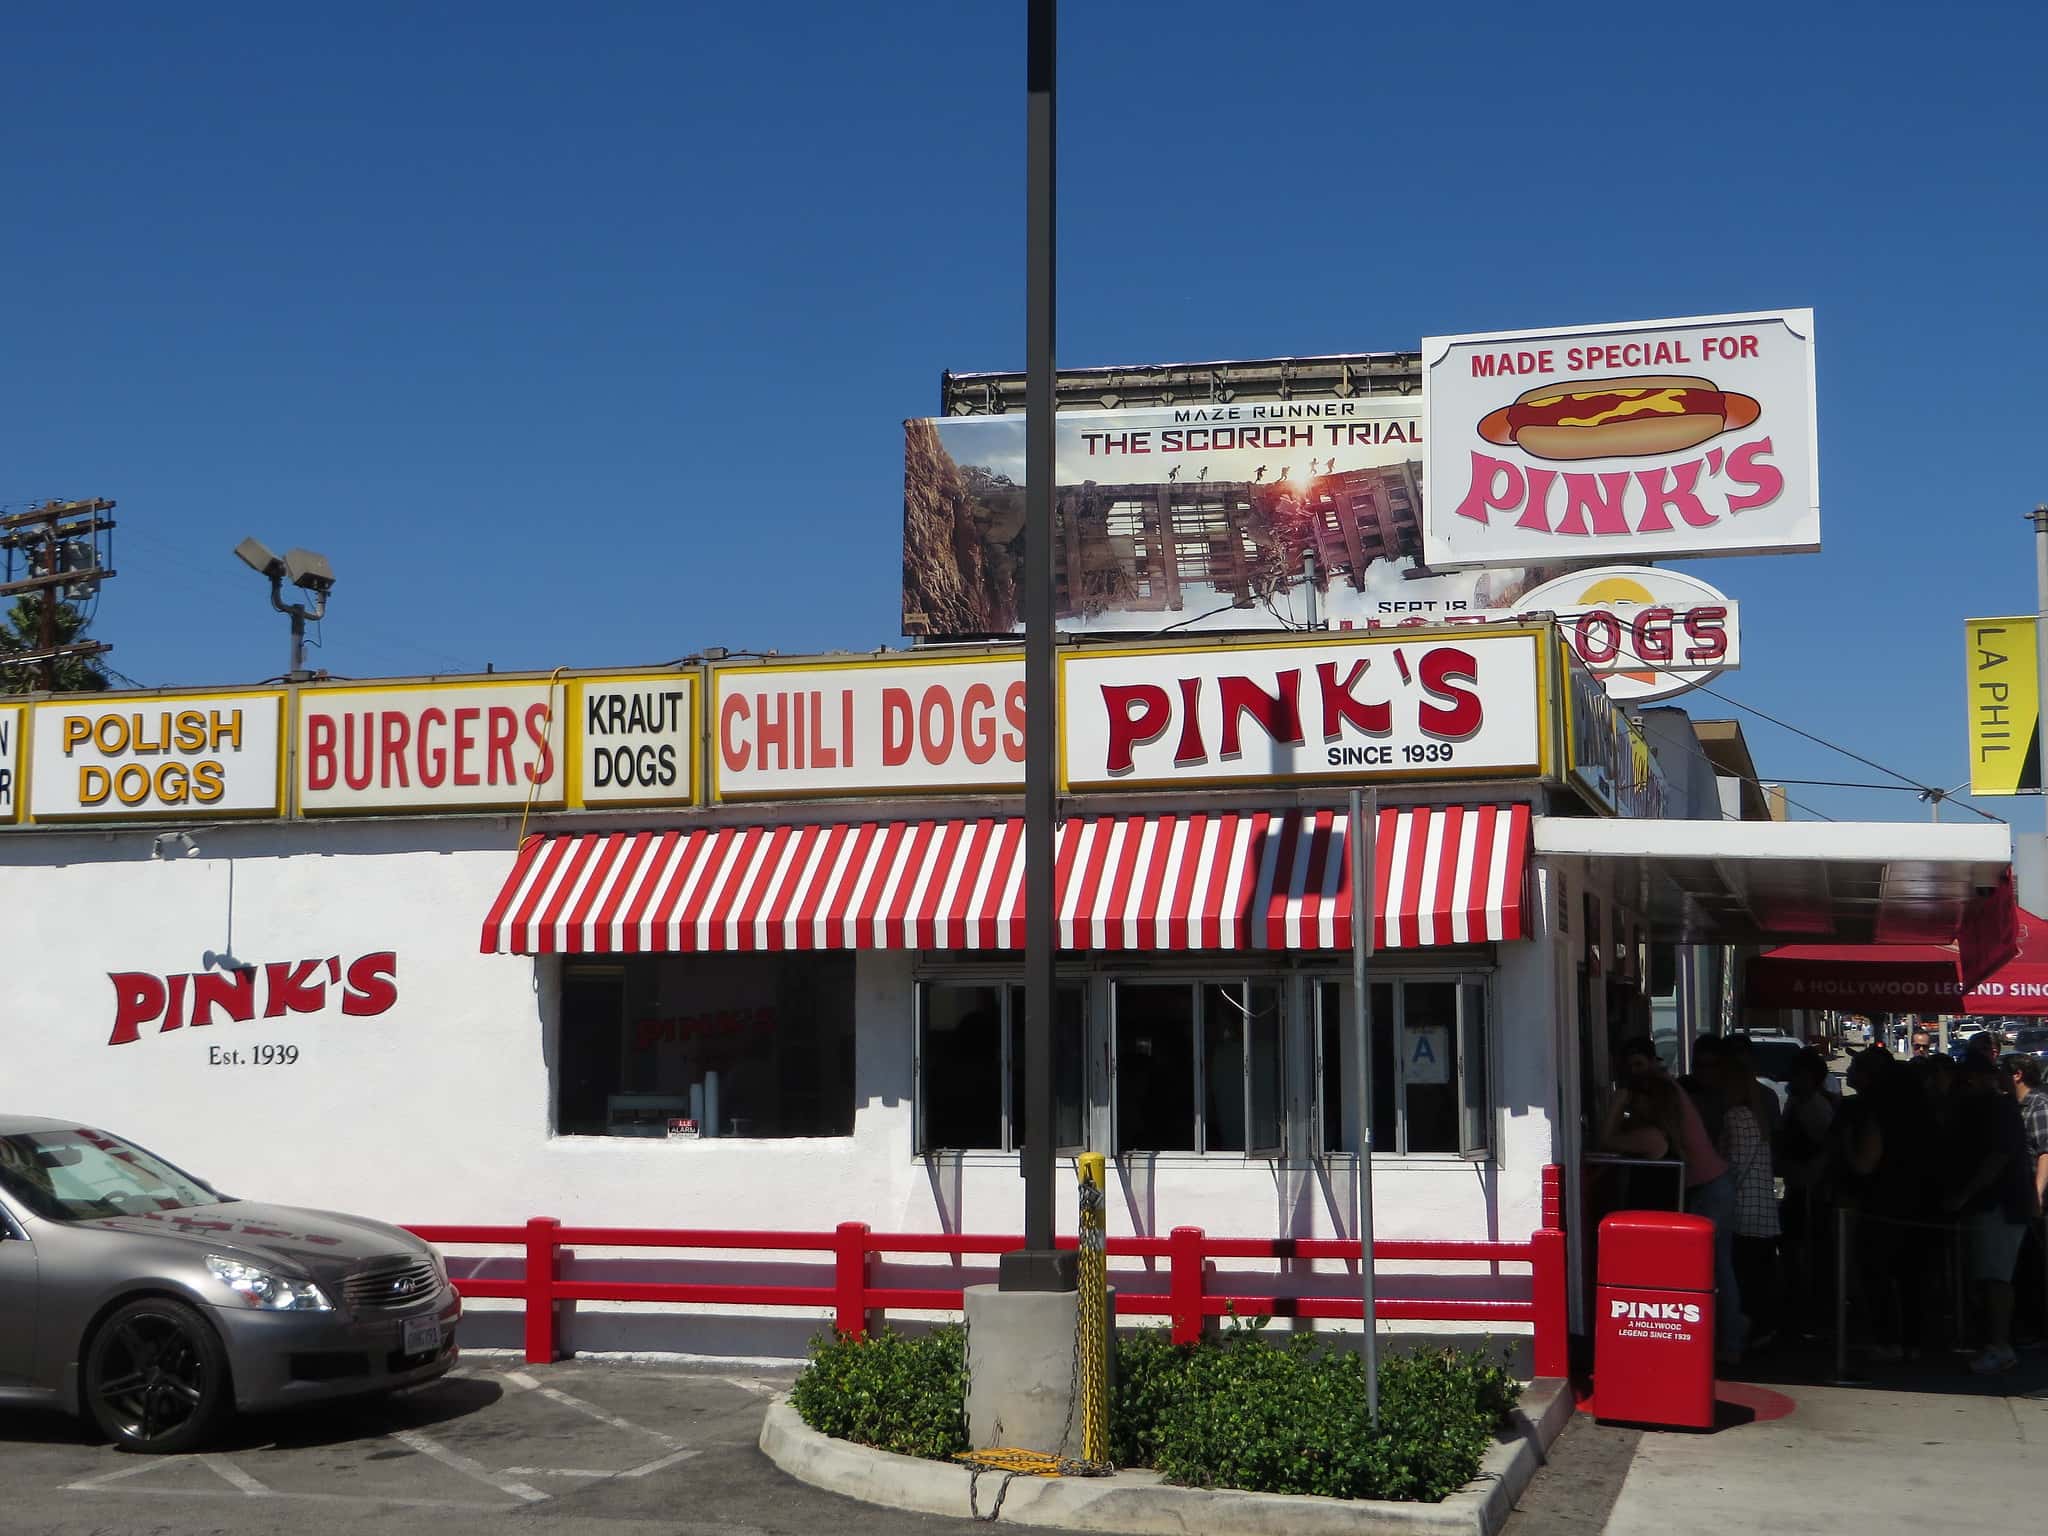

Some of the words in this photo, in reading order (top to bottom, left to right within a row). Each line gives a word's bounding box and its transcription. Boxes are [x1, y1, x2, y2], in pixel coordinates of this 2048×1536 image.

[1472, 351, 1554, 377] MADE
[1567, 341, 1690, 371] SPECIAL
[1703, 335, 1759, 362] FOR
[1175, 407, 1241, 423] MAZE
[1253, 403, 1355, 419] RUNNER
[1081, 432, 1151, 456] THE
[1161, 424, 1313, 453] SCORCH
[1455, 436, 1784, 536] PINK'S
[1378, 601, 1437, 614] SEPT
[1446, 600, 1467, 612] 18
[1562, 607, 1728, 664] OGS
[1977, 628, 2009, 671] LA
[63, 709, 242, 755] POLISH
[588, 691, 683, 736] KRAUT
[721, 689, 855, 772] CHILI
[882, 680, 1027, 767] DOGS
[1100, 648, 1484, 777] PINK'S
[1979, 682, 2011, 763] PHIL
[308, 702, 555, 791] BURGERS
[594, 744, 677, 788] DOGS
[1328, 745, 1393, 766] SINCE
[1402, 743, 1454, 763] 1939
[79, 760, 226, 806] DOGS
[107, 951, 398, 1045] PINK'S
[1809, 980, 1929, 995] HOLLYWOOD
[209, 1047, 246, 1066] Est.
[252, 1045, 299, 1066] 1939
[1412, 1036, 1436, 1062] A
[1611, 1300, 1700, 1322] PINK'S
[1635, 1321, 1682, 1331] HOLLYWOOD
[1618, 1329, 1648, 1338] LEGEND
[1649, 1331, 1672, 1340] SINCE
